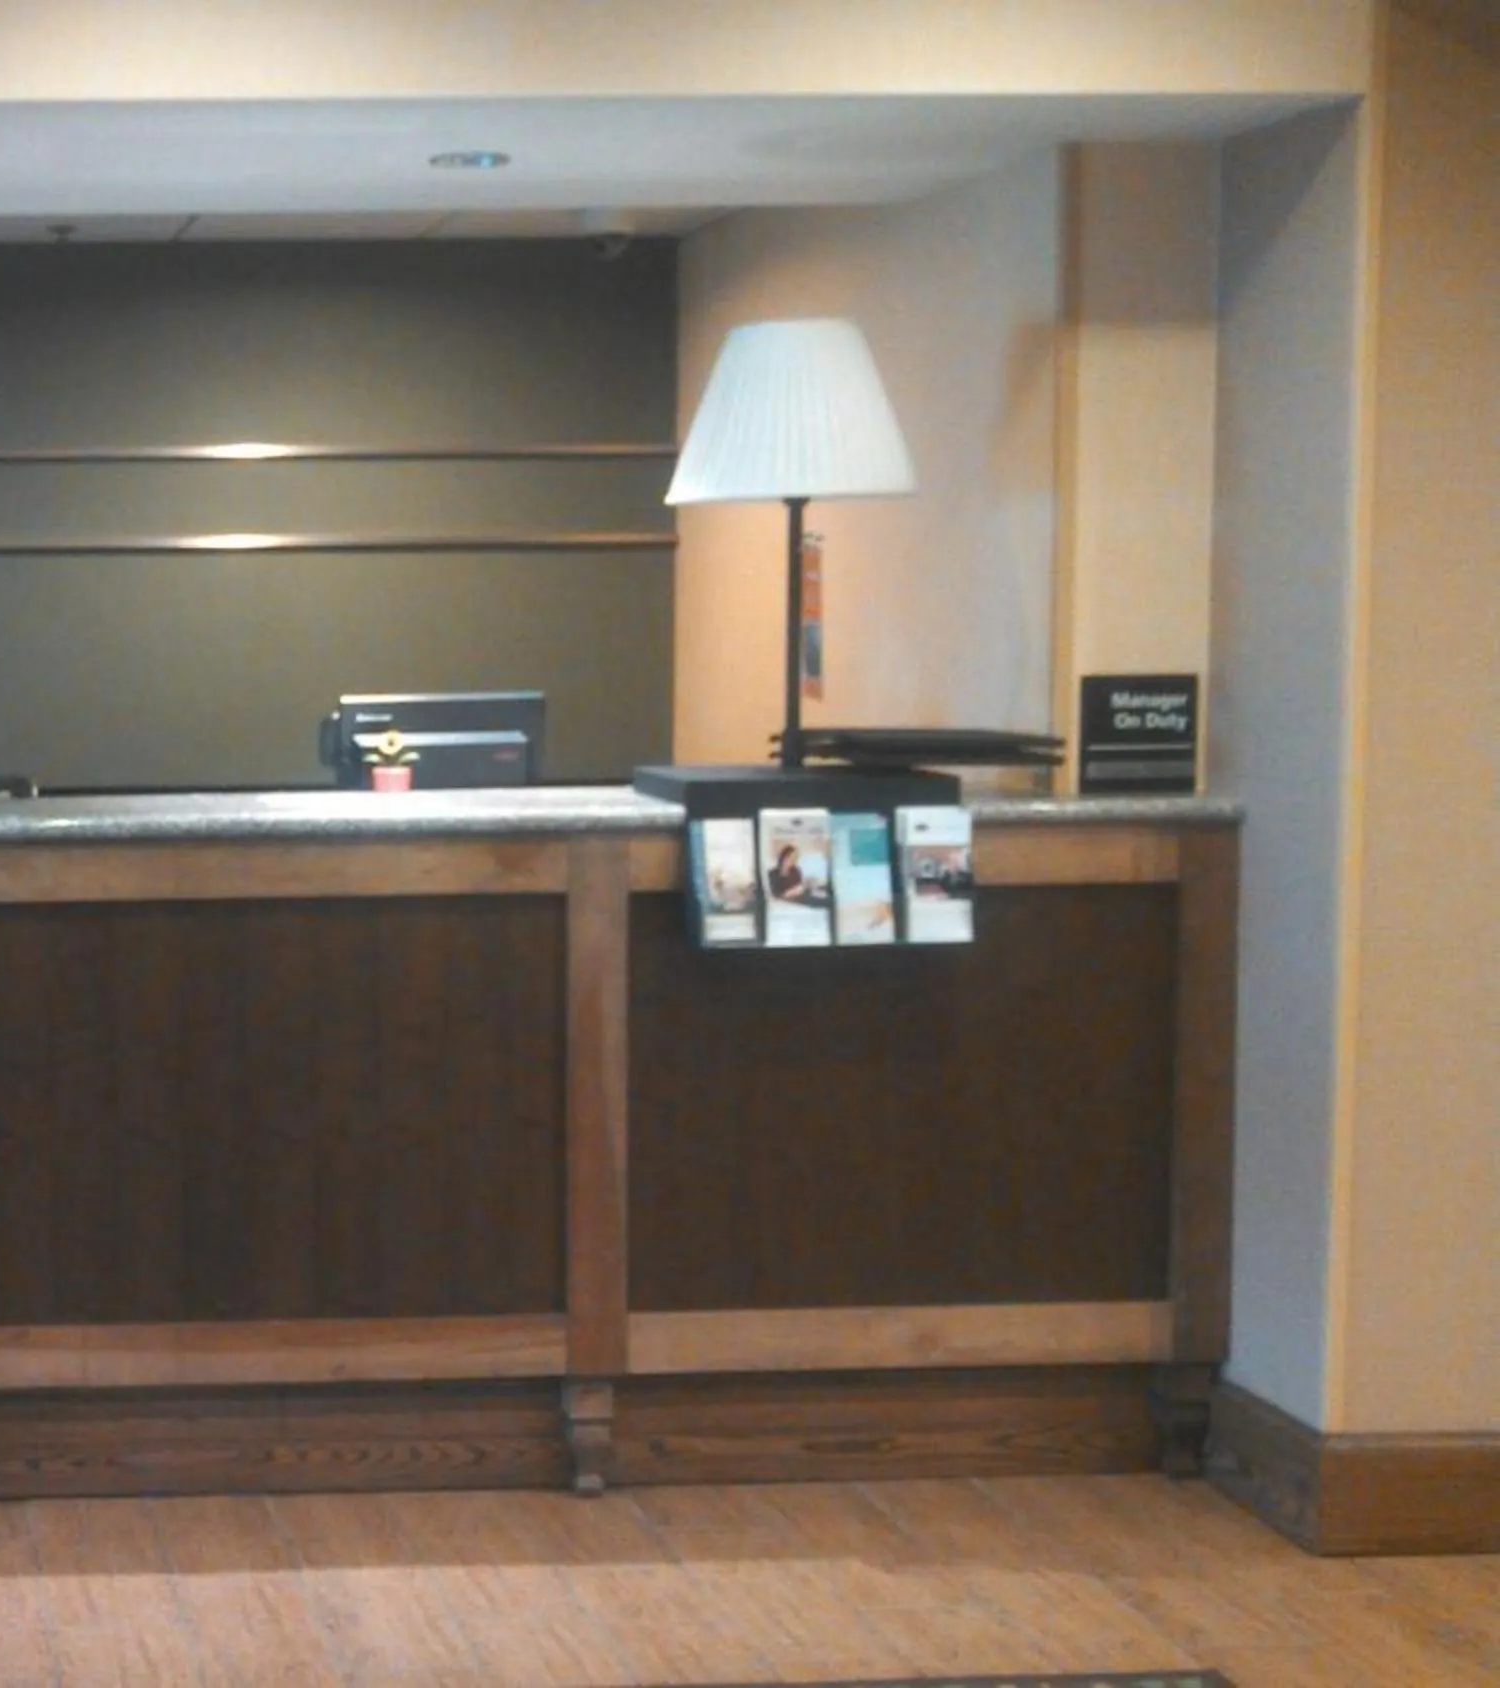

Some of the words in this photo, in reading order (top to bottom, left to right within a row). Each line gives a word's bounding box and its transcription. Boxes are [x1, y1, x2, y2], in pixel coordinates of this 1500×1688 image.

[1110, 691, 1188, 712] Manager
[1113, 711, 1141, 730] On
[1145, 711, 1188, 733] Duty
